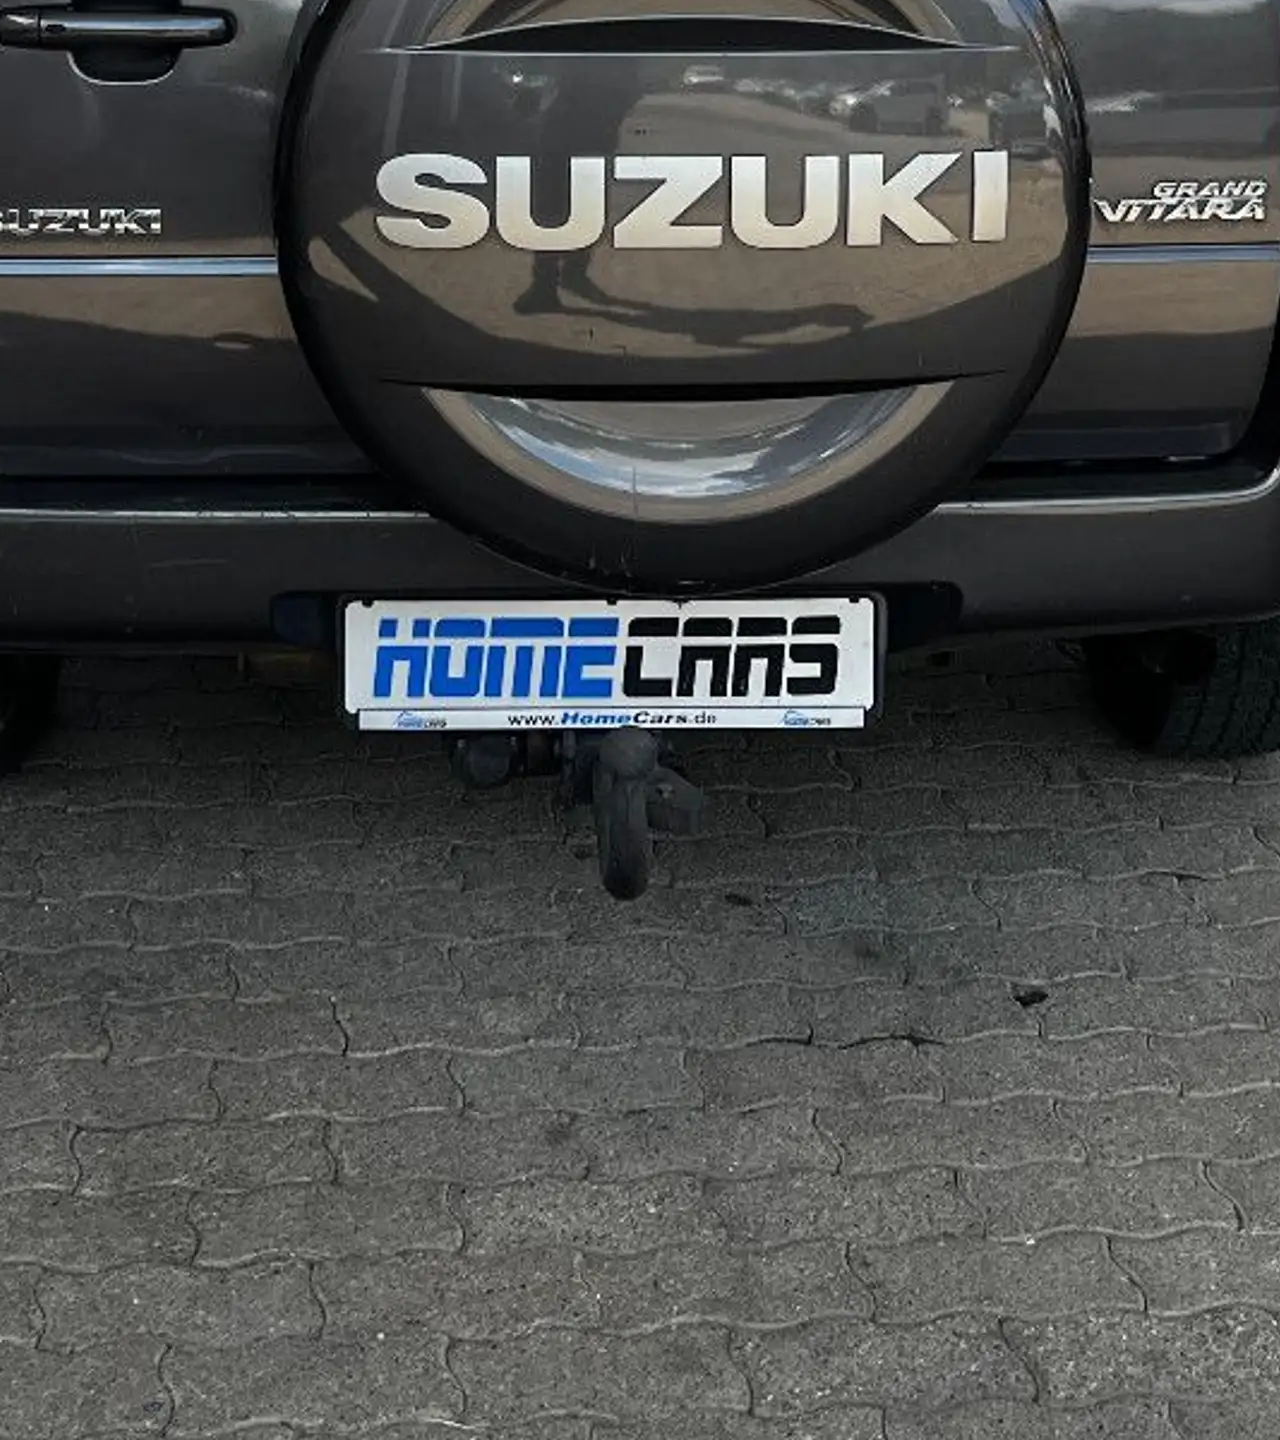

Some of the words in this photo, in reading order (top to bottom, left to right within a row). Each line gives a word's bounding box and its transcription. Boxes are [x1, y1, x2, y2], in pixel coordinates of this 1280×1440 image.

[1153, 180, 1267, 198] GRAND
[375, 150, 1009, 251] SUZUKI
[1093, 198, 1265, 222] VITARA
[507, 711, 717, 728] www.HomeCars.de
